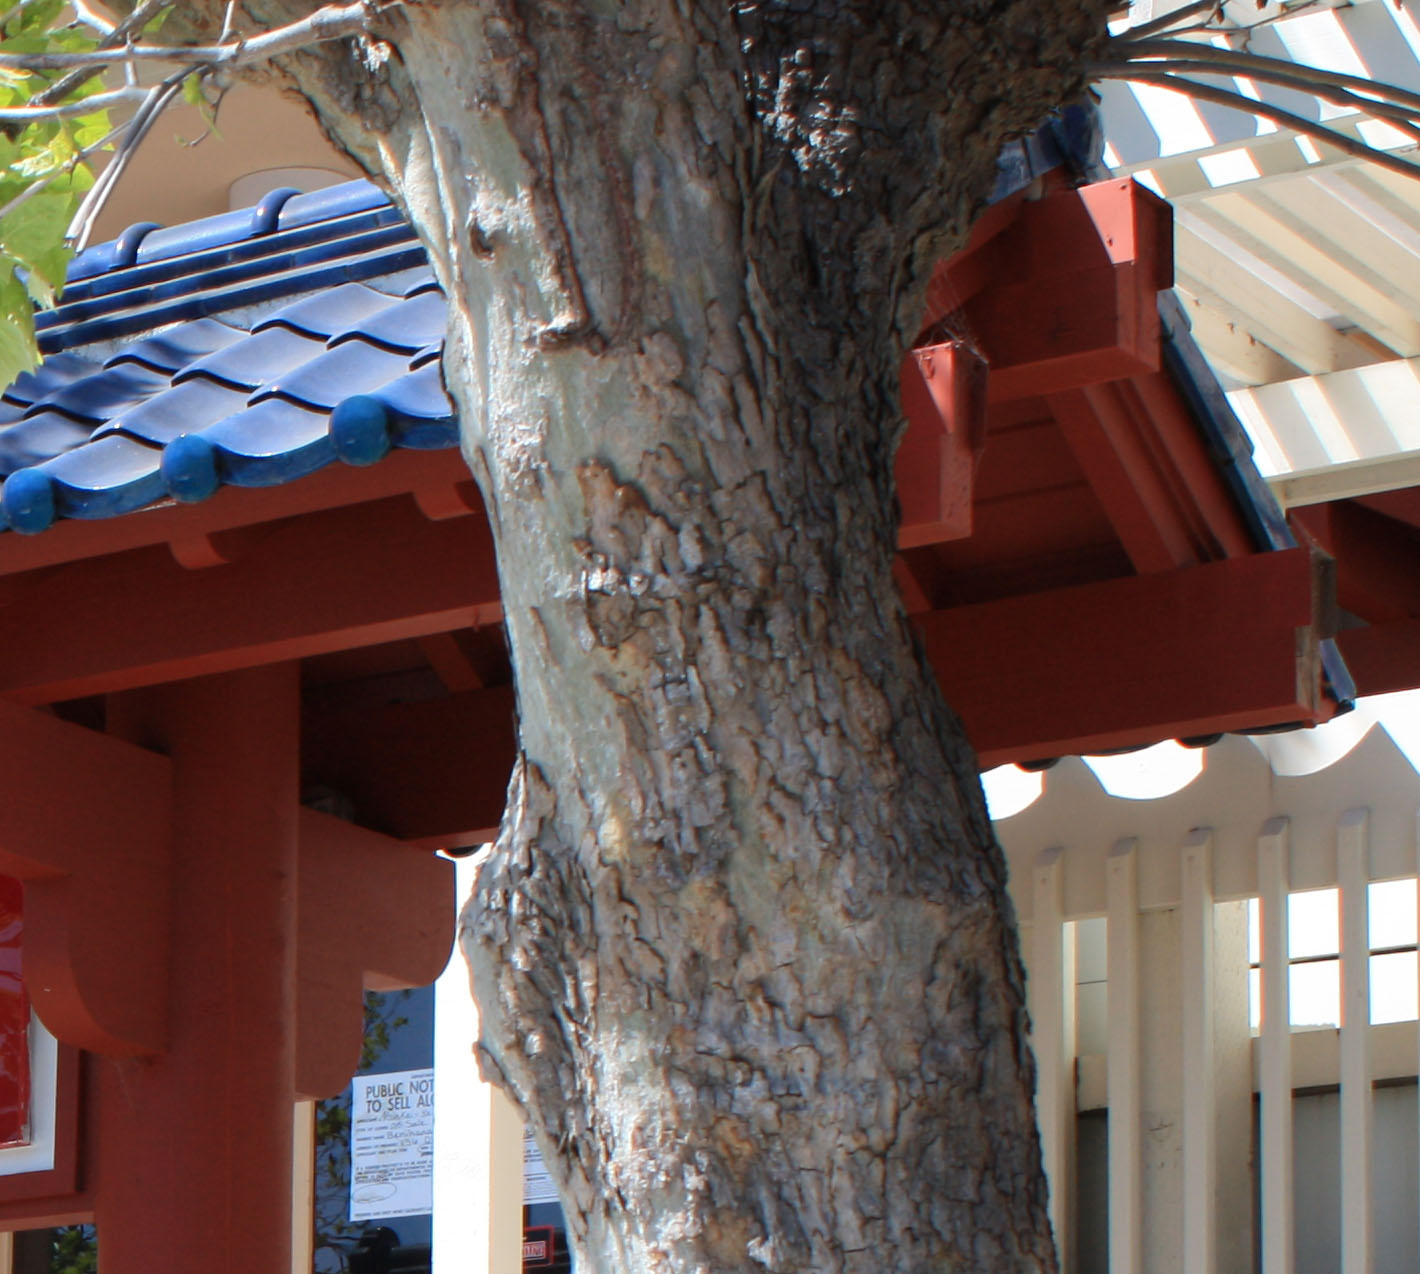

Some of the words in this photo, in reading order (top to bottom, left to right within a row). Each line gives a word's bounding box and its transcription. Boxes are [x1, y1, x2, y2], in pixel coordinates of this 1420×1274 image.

[366, 1082, 403, 1098] PUBLIC
[366, 1099, 382, 1113] TO
[388, 1096, 410, 1111] SELL
